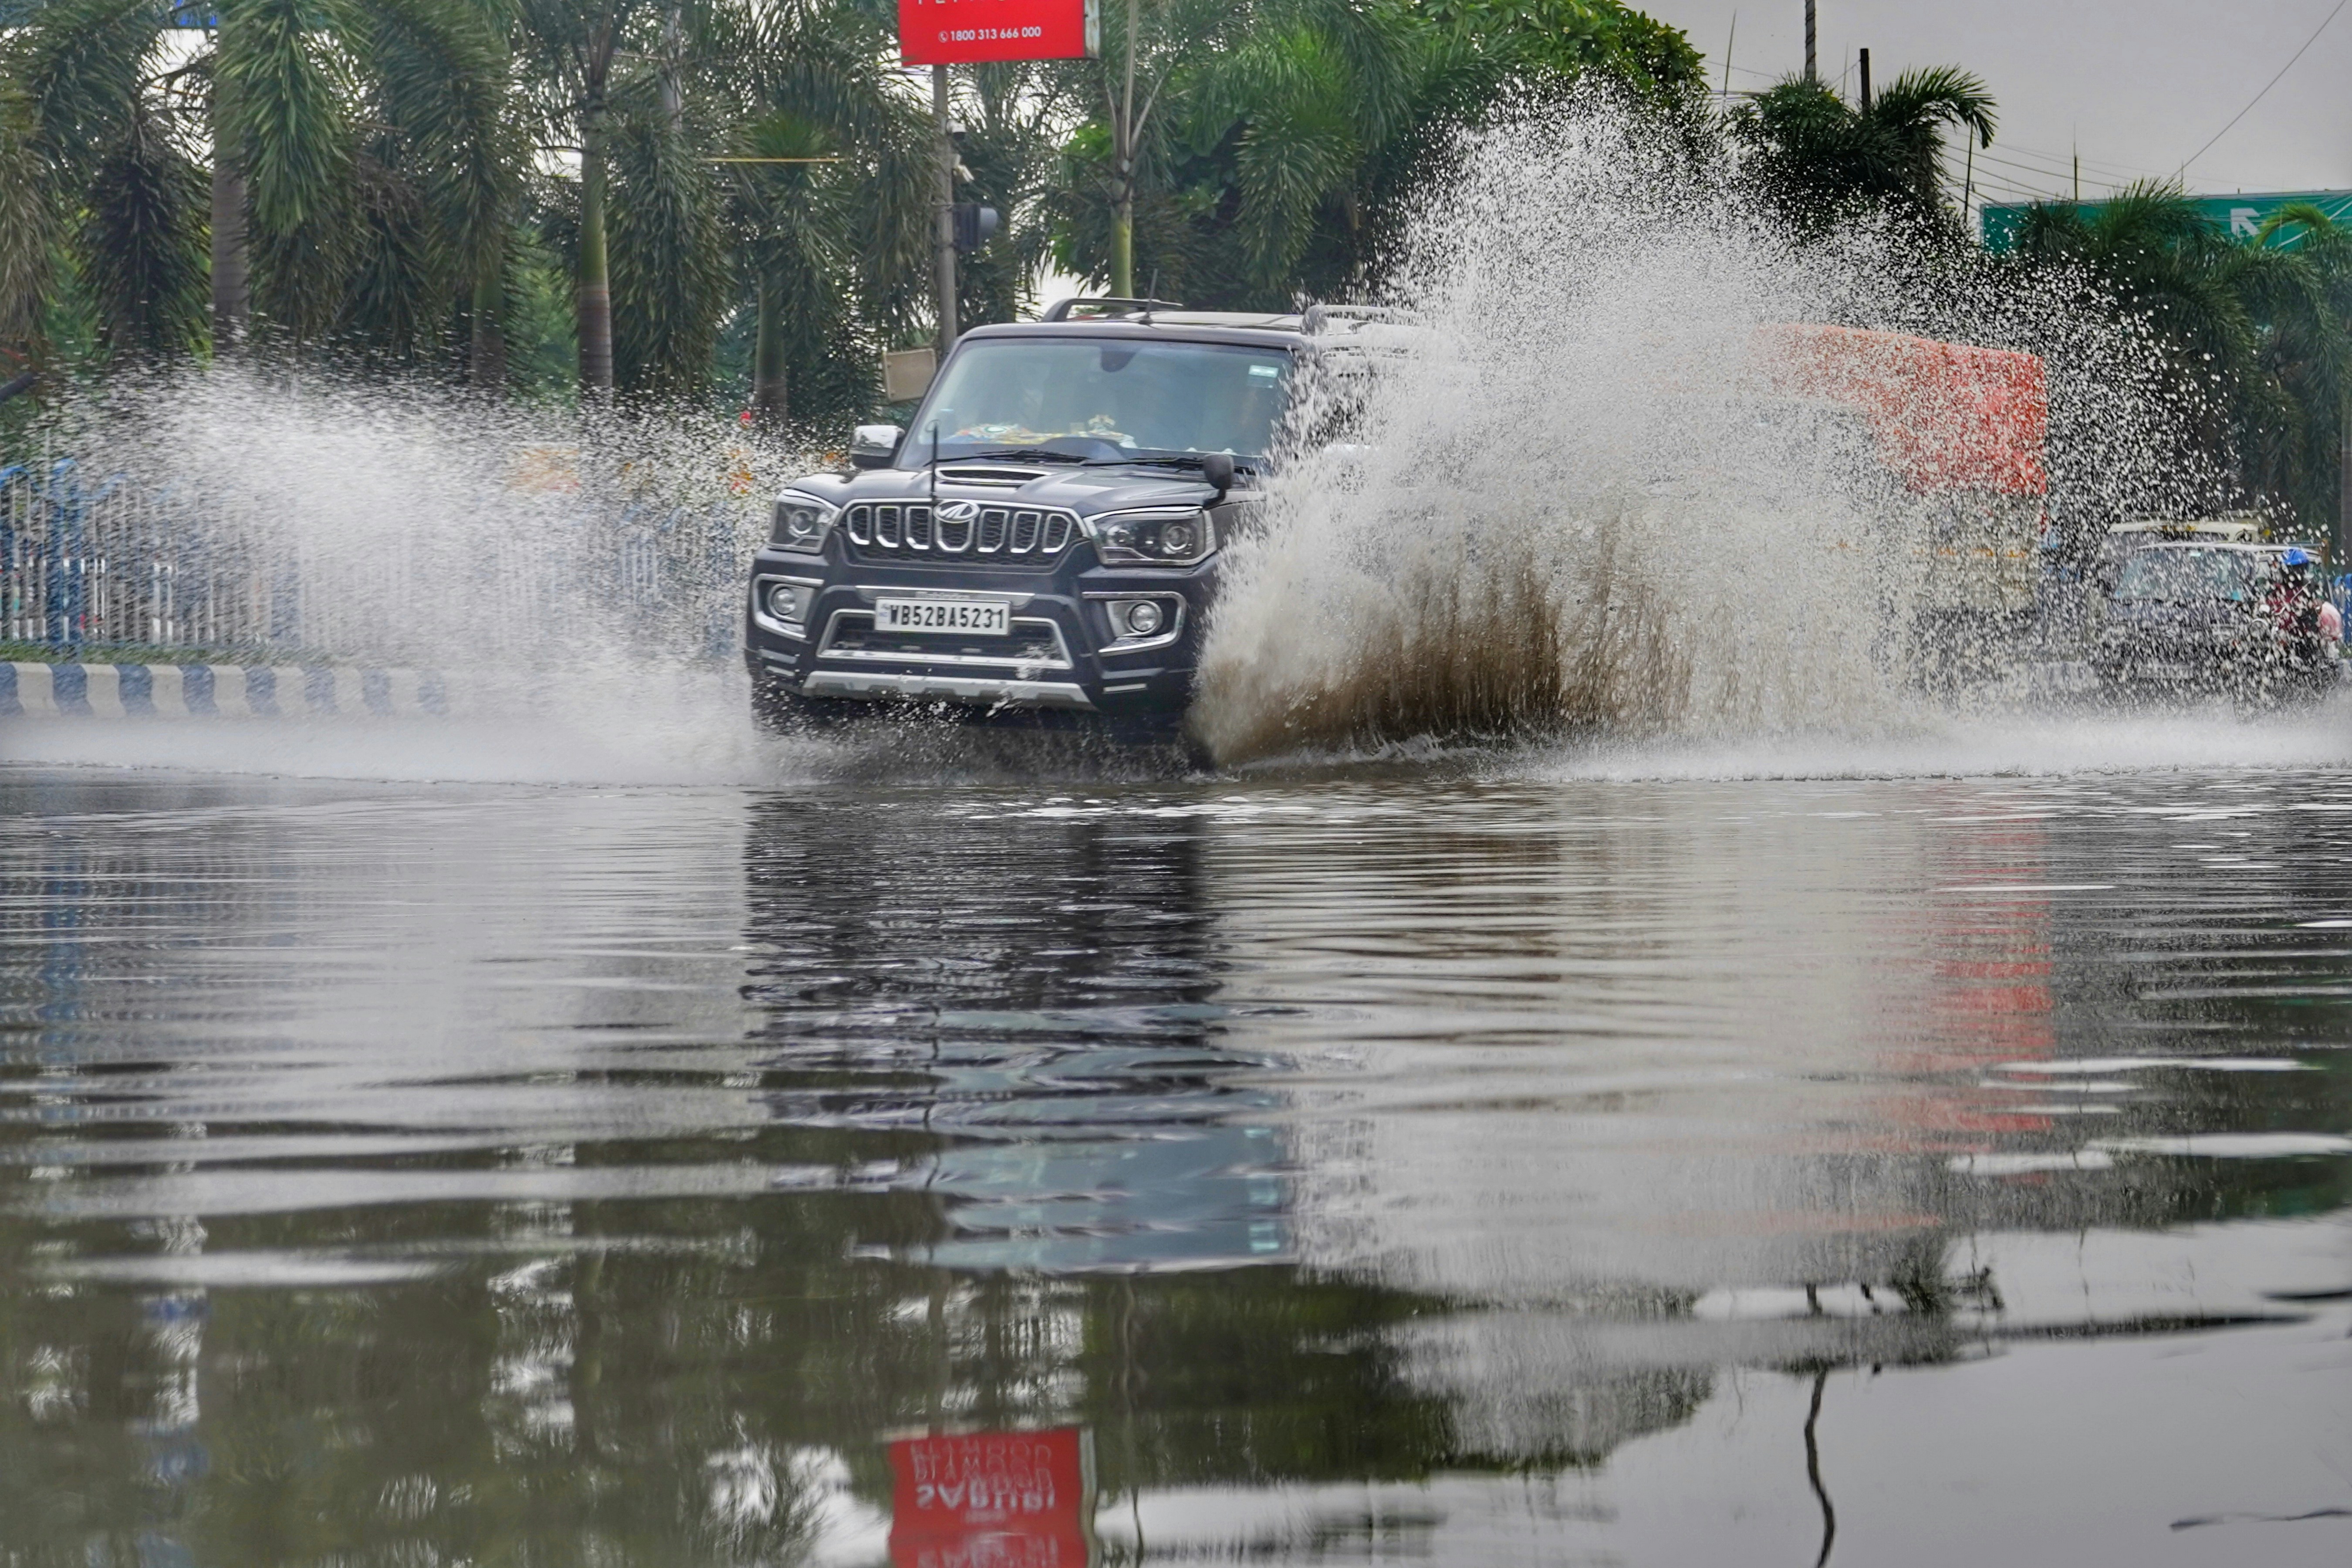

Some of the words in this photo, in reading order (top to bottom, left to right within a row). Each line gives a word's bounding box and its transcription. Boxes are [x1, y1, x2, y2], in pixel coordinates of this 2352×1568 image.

[950, 30, 976, 41] 1800
[978, 28, 997, 40] 313
[1000, 27, 1019, 39] 666
[1021, 26, 1041, 37] 000
[889, 605, 1004, 629] WB52BA5231
